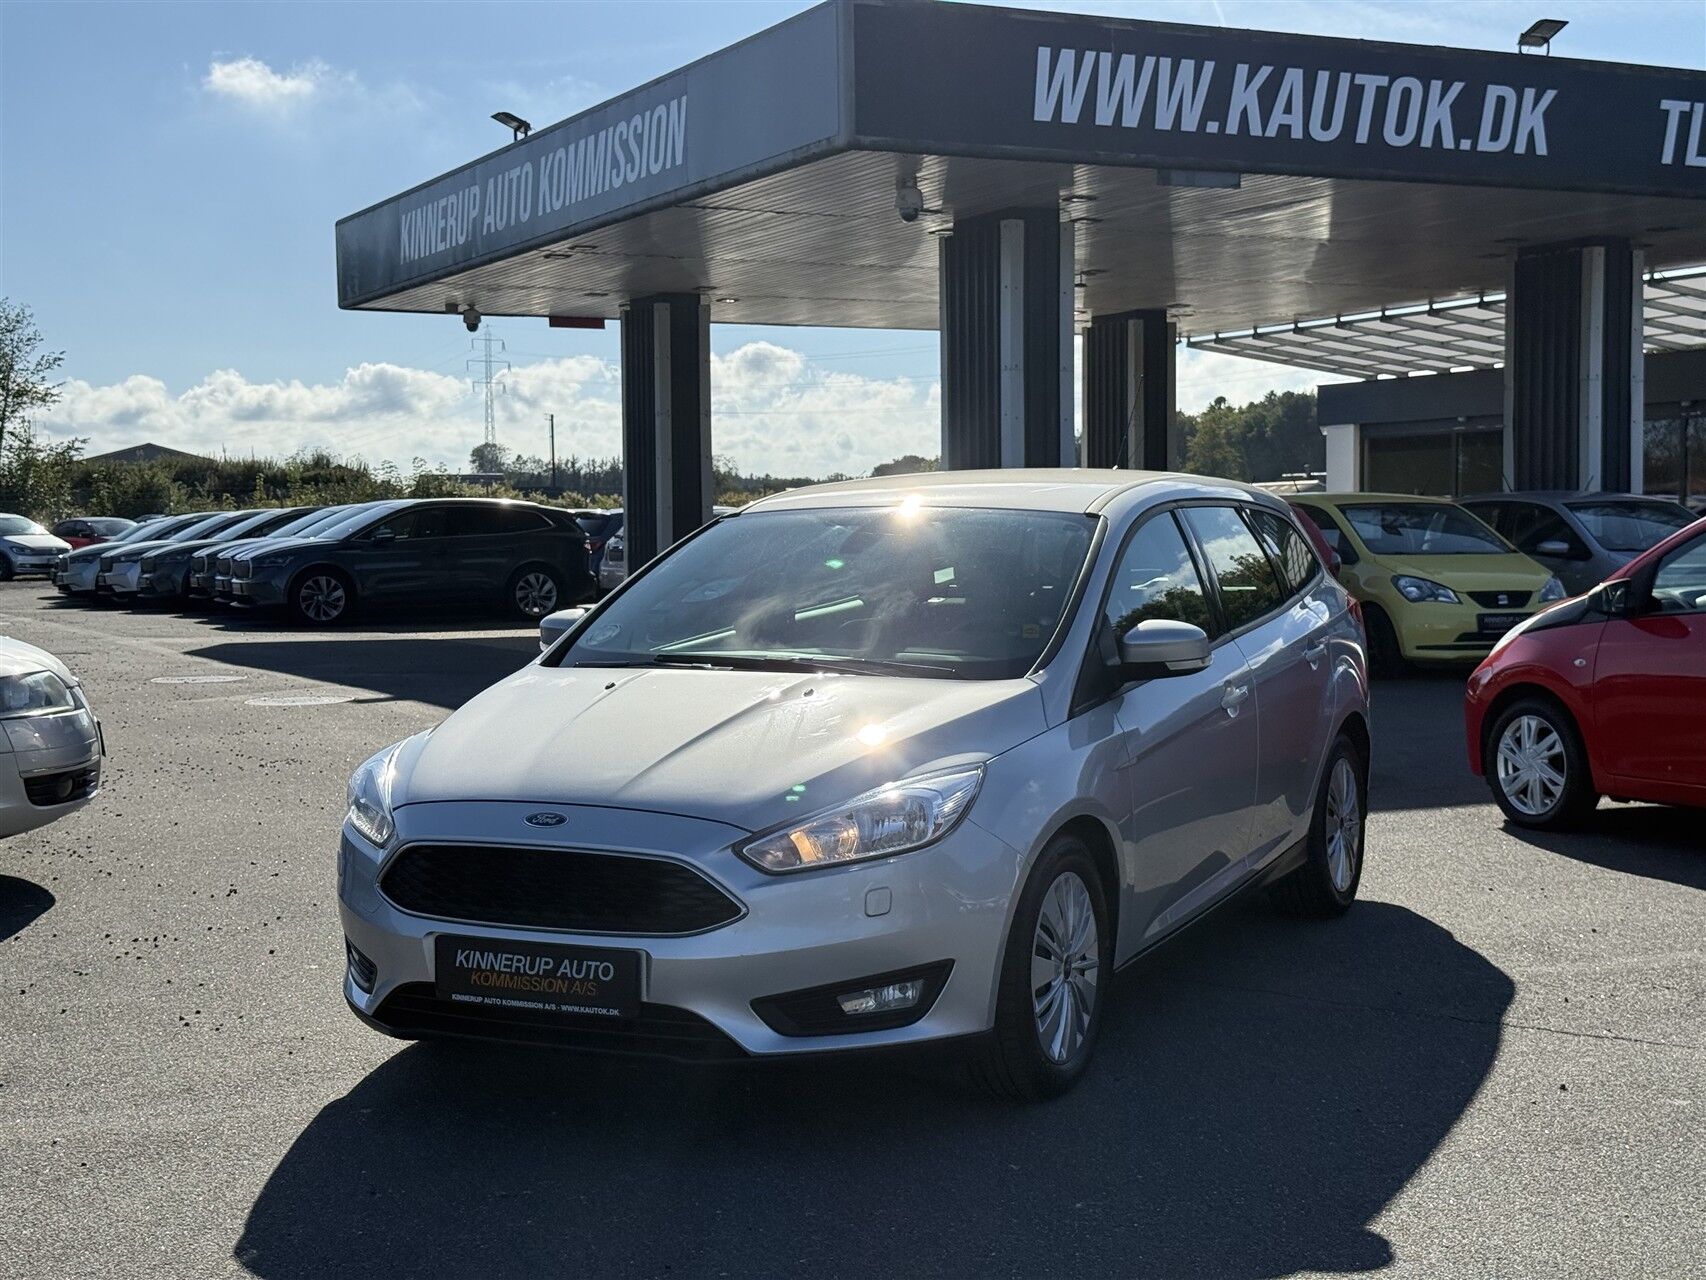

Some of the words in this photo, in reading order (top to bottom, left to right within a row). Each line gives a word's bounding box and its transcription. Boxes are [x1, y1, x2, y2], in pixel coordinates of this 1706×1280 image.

[1033, 46, 1558, 157] WWW.KAUTOK.DK
[400, 184, 480, 266] KINNERUP
[482, 161, 533, 236] AUTO
[537, 95, 687, 217] KOMMISSION
[532, 813, 560, 824] Ford
[455, 949, 554, 975] KINNERUP
[556, 959, 615, 981] AUTO
[470, 971, 568, 993] KOMMISSION
[570, 981, 598, 996] A/S
[452, 993, 483, 1003] KINNERUP
[484, 997, 501, 1005] AUTO
[502, 999, 544, 1009] KOMMISSION
[561, 1004, 620, 1016] WWW.KAUTOK.DK
